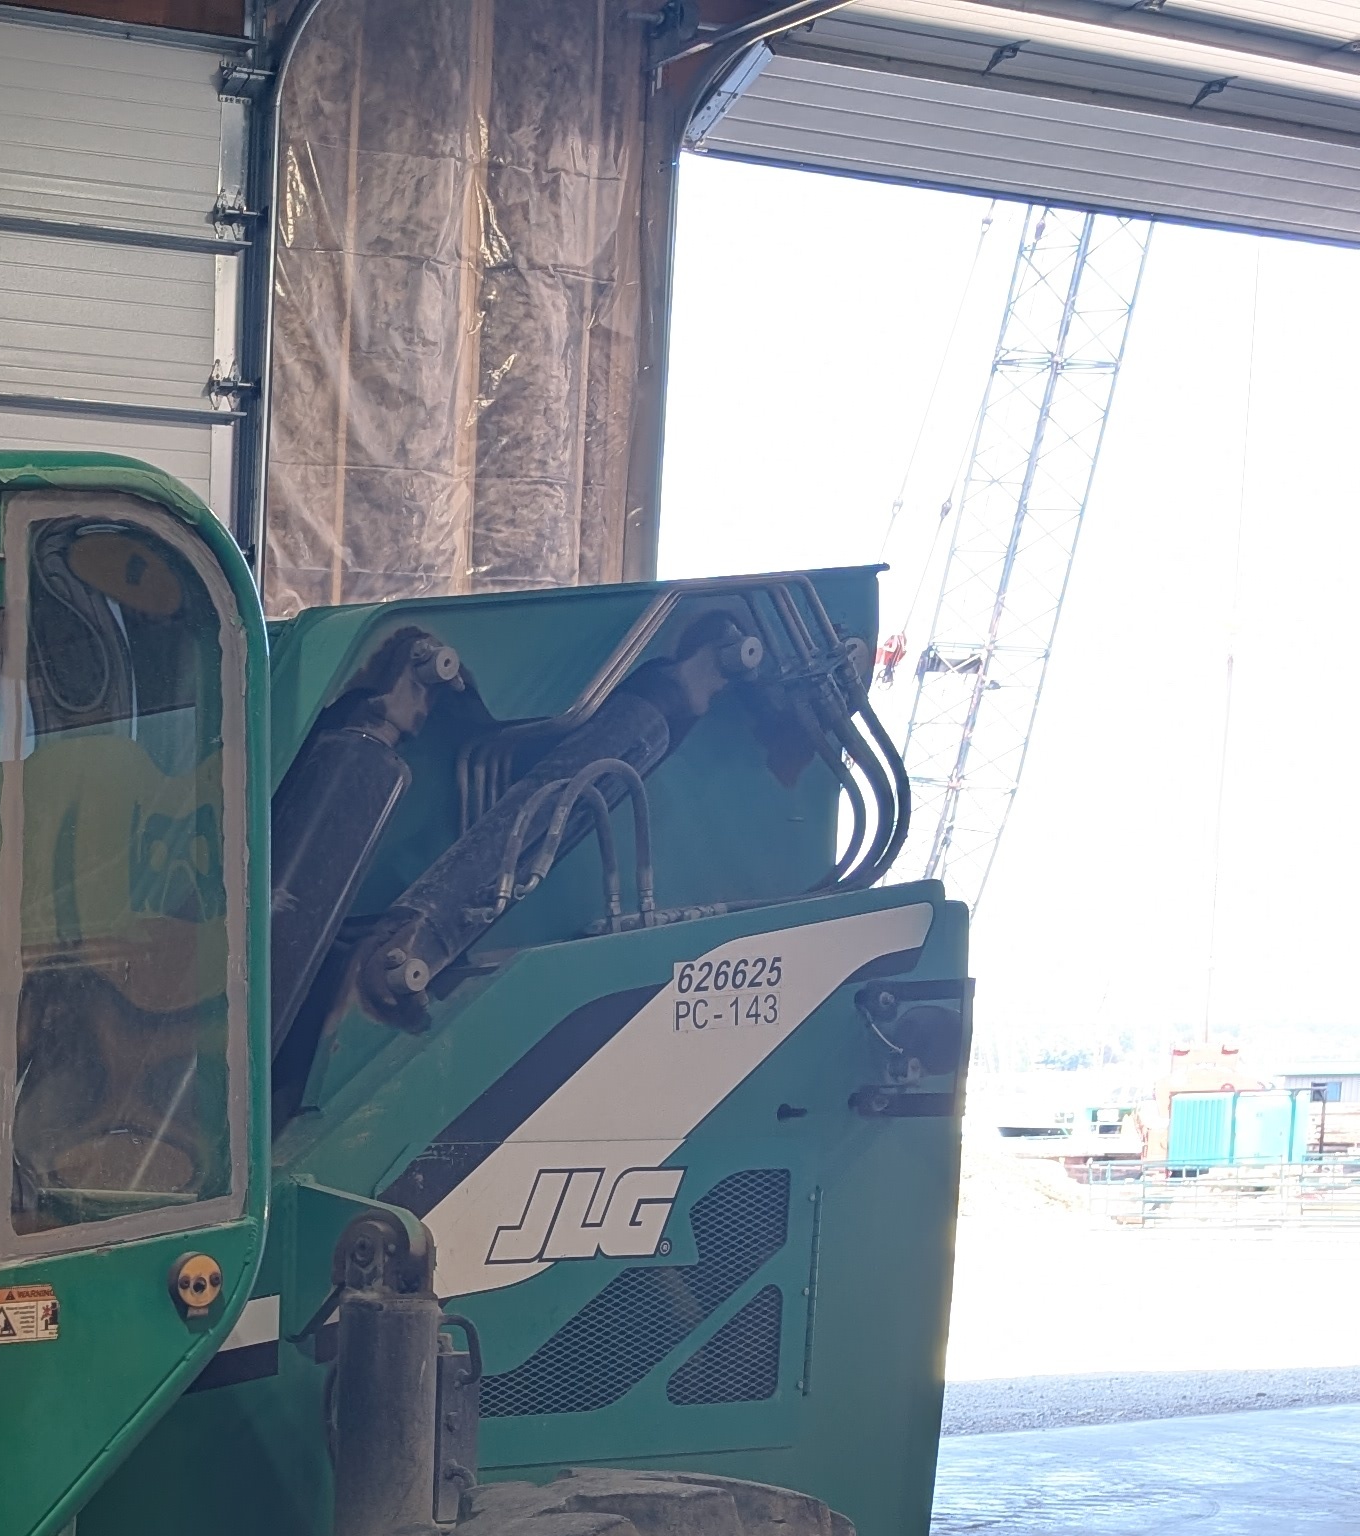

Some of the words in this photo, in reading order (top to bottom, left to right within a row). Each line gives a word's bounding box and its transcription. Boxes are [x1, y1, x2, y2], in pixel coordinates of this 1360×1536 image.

[677, 956, 782, 994] 626625
[675, 994, 778, 1031] PC-143
[484, 1165, 688, 1265] JLG
